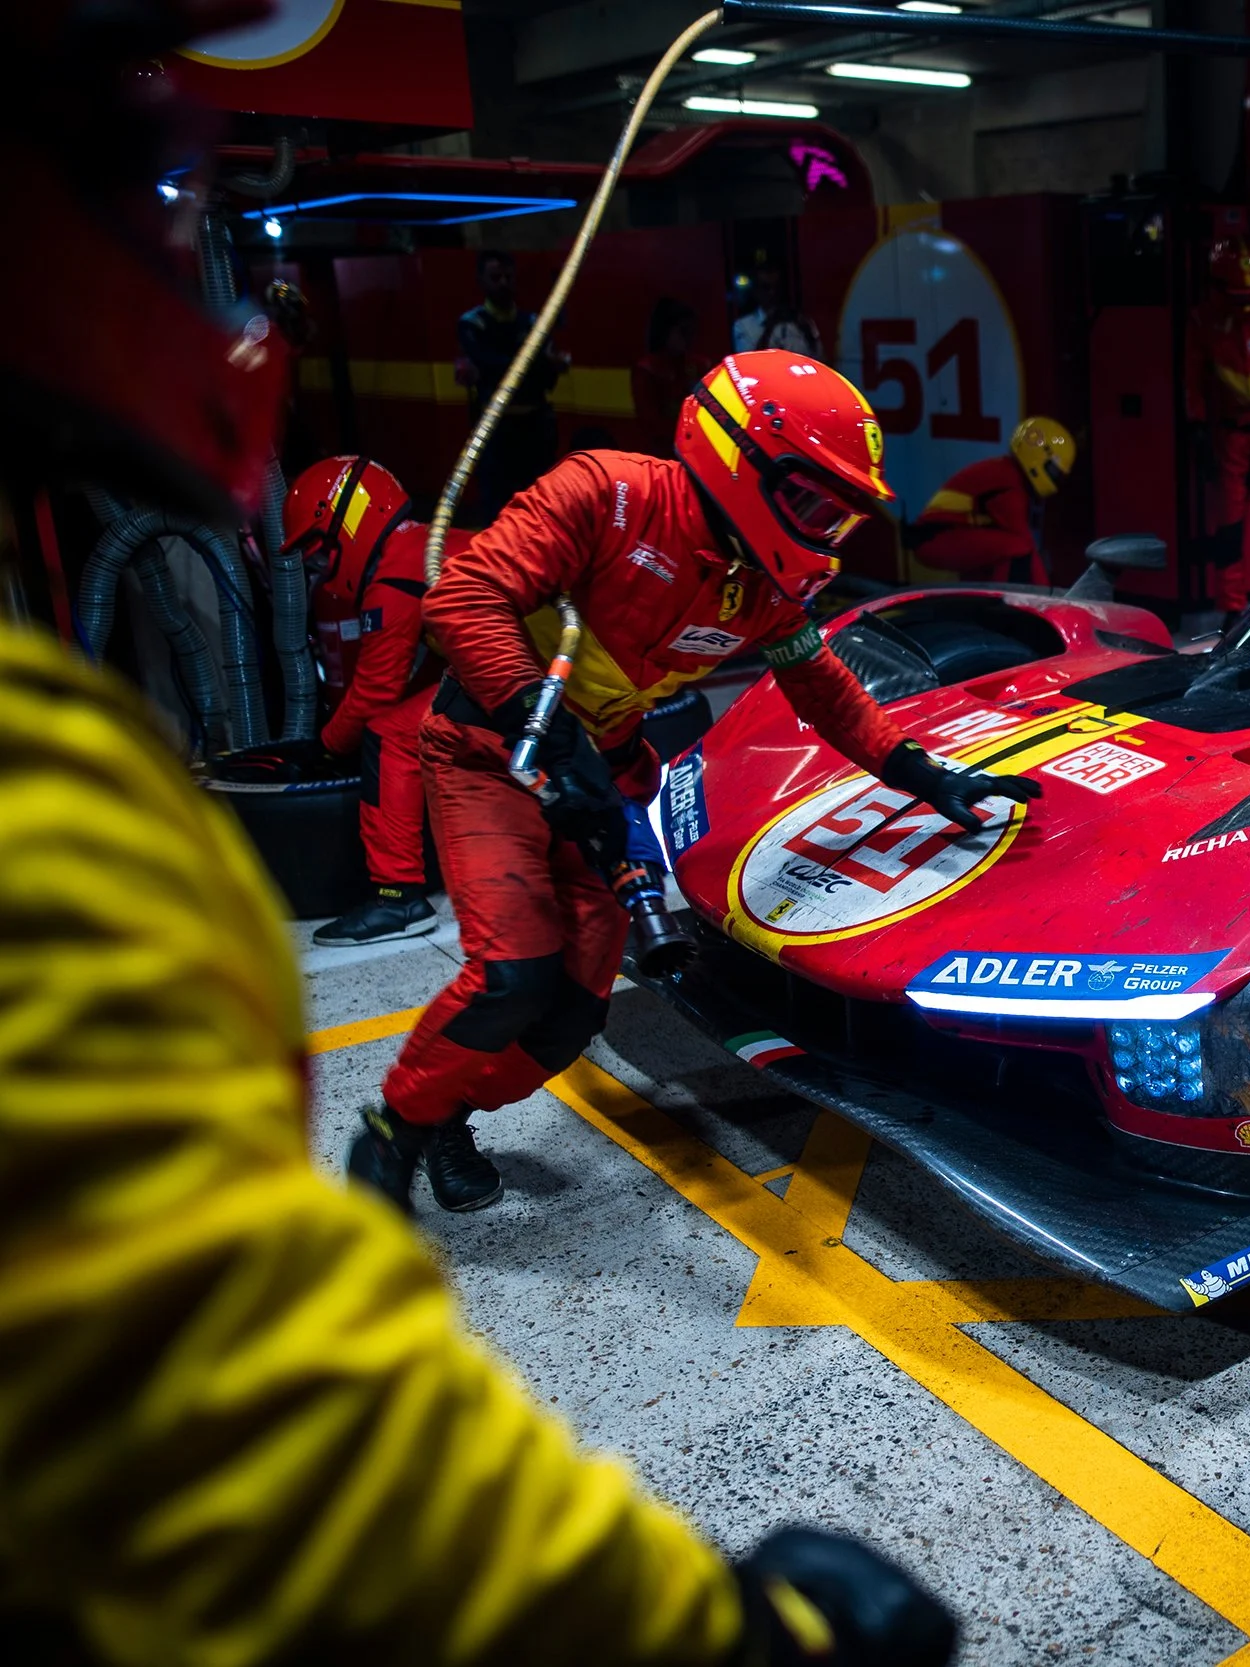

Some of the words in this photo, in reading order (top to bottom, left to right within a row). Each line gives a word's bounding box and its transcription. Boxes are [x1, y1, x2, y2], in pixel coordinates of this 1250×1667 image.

[861, 318, 1000, 442] 51
[612, 480, 629, 531] Sabelt
[765, 627, 820, 665] PITLANE
[1052, 755, 1132, 789] CAR
[1084, 744, 1155, 774] HYPER
[668, 763, 696, 818] ADLER
[802, 786, 953, 879] 51
[786, 865, 853, 894] WEC
[931, 957, 1082, 987] ADLER
[1129, 962, 1189, 977] PELZER
[1122, 976, 1182, 992] GROUP
